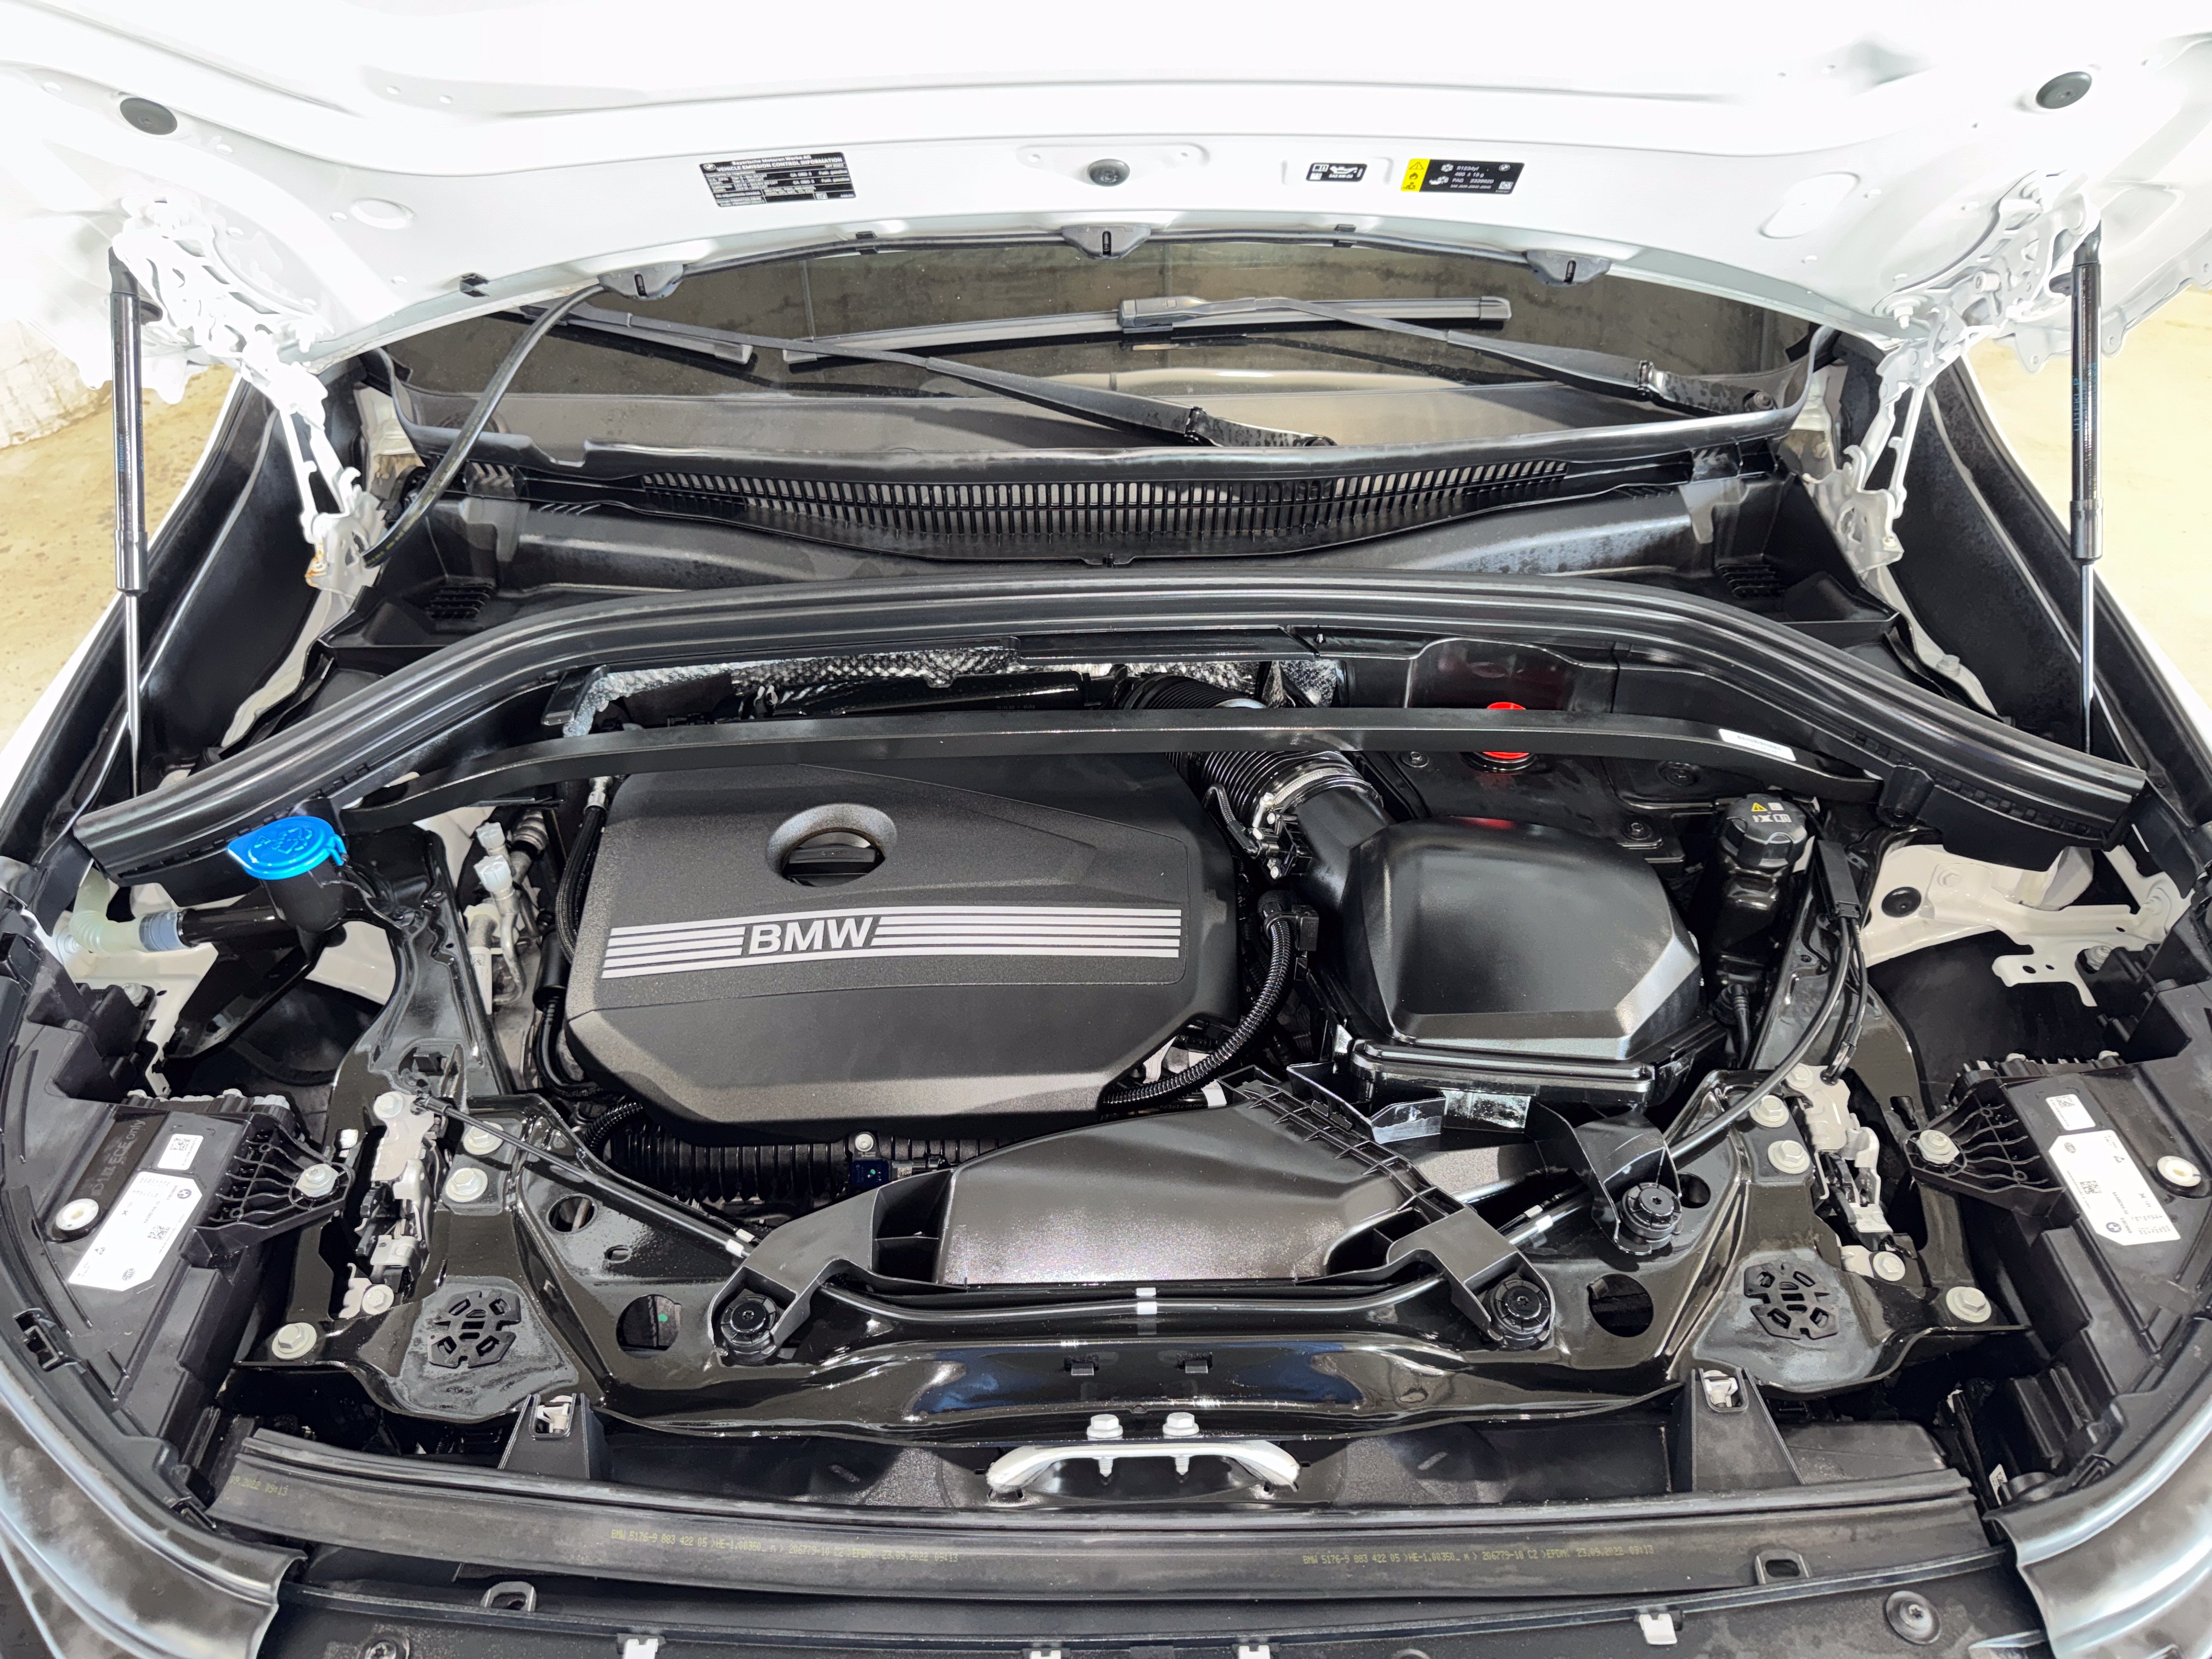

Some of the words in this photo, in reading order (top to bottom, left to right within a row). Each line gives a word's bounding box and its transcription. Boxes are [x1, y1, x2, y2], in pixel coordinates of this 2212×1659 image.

[801, 156, 843, 165] INFORMATION
[748, 916, 875, 956] BMW
[108, 1141, 131, 1164] ECE
[126, 1120, 146, 1139] only
[611, 1528, 627, 1540] BMW
[629, 1531, 658, 1543] 5176-9
[661, 1533, 676, 1545] 883
[679, 1535, 694, 1547] 422
[697, 1537, 708, 1548] 05
[1302, 1554, 1318, 1565] BMW
[1321, 1553, 1350, 1564] 5176-9
[1353, 1553, 1369, 1564] 883
[1372, 1553, 1387, 1564] 422
[1390, 1553, 1401, 1563] 05
[1481, 1549, 1525, 1561] 206779-10
[1527, 1549, 1538, 1559] CZ
